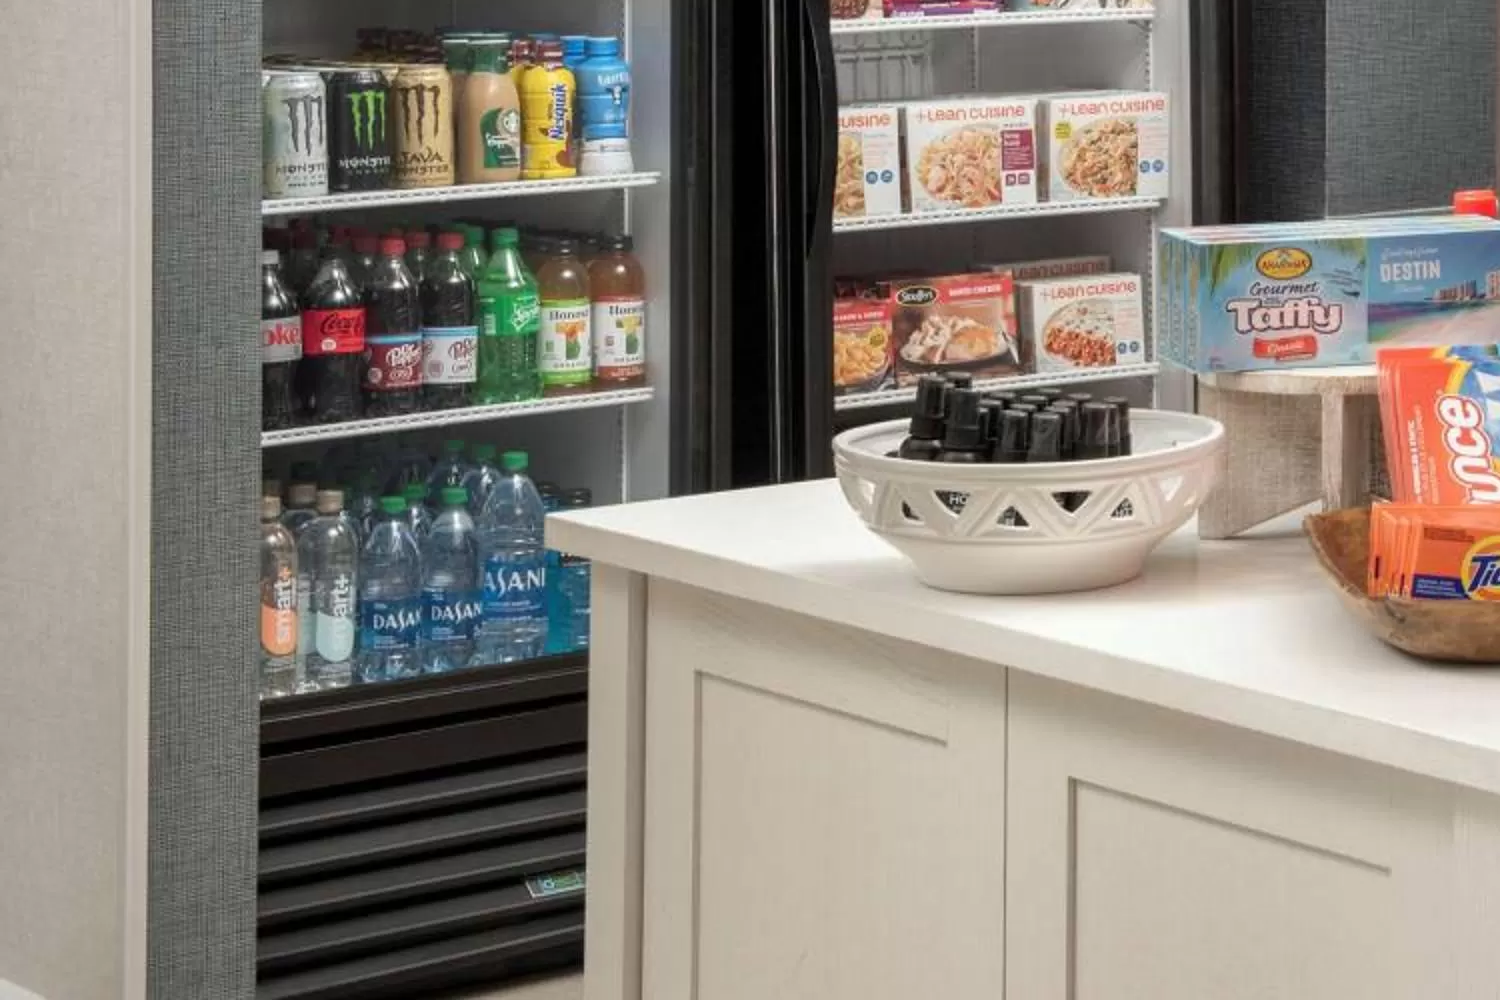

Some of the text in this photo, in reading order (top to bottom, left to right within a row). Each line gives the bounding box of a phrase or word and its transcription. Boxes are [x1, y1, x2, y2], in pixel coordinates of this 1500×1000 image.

[1380, 258, 1442, 282] DESTIN
[1249, 281, 1319, 297] Gourmet
[1225, 295, 1343, 335] Taffy
